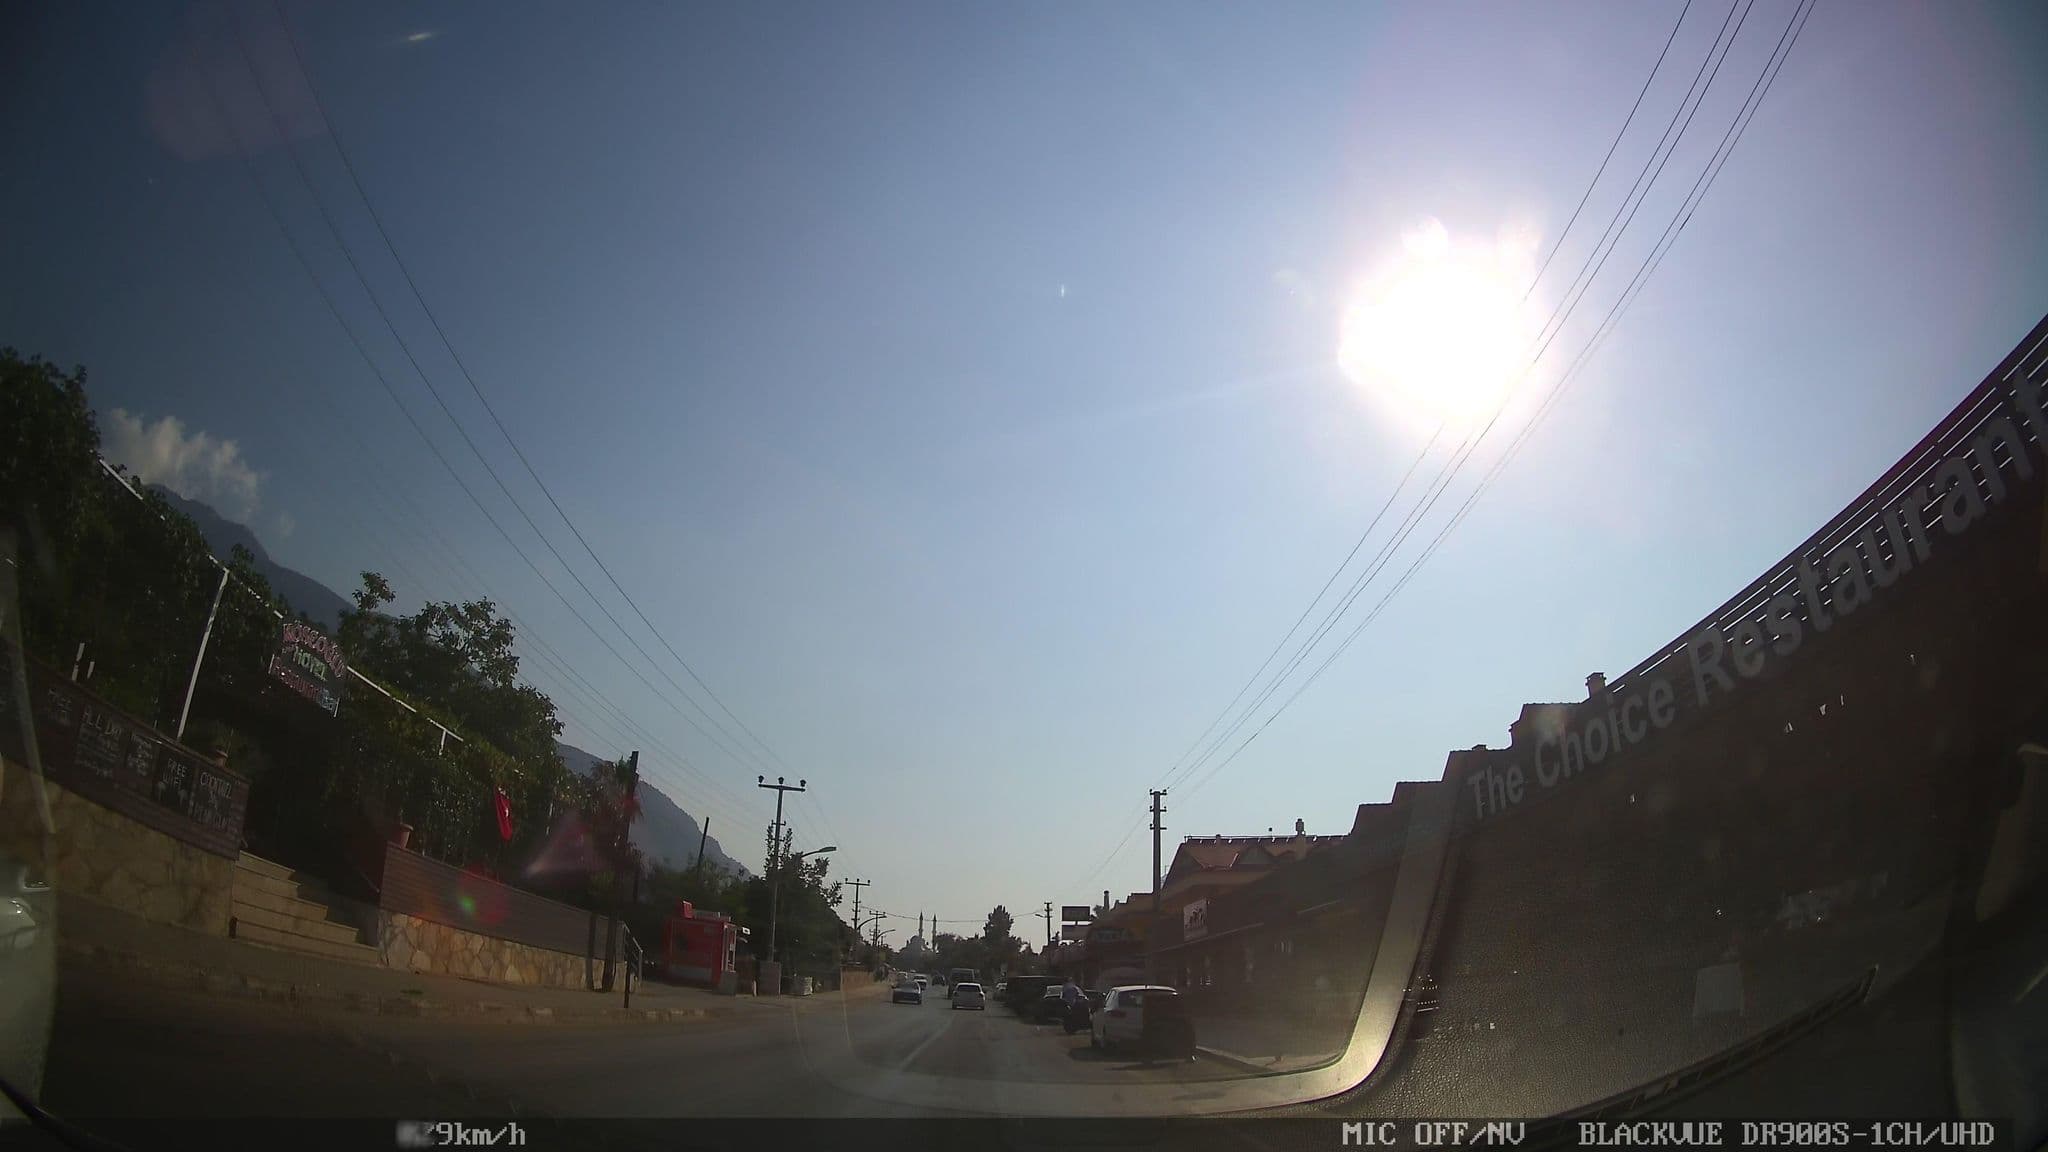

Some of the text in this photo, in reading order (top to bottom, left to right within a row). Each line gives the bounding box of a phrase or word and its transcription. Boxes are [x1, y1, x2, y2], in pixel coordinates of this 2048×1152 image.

[1467, 366, 2048, 819] The Choice Restaurant
[167, 757, 188, 777] FREE
